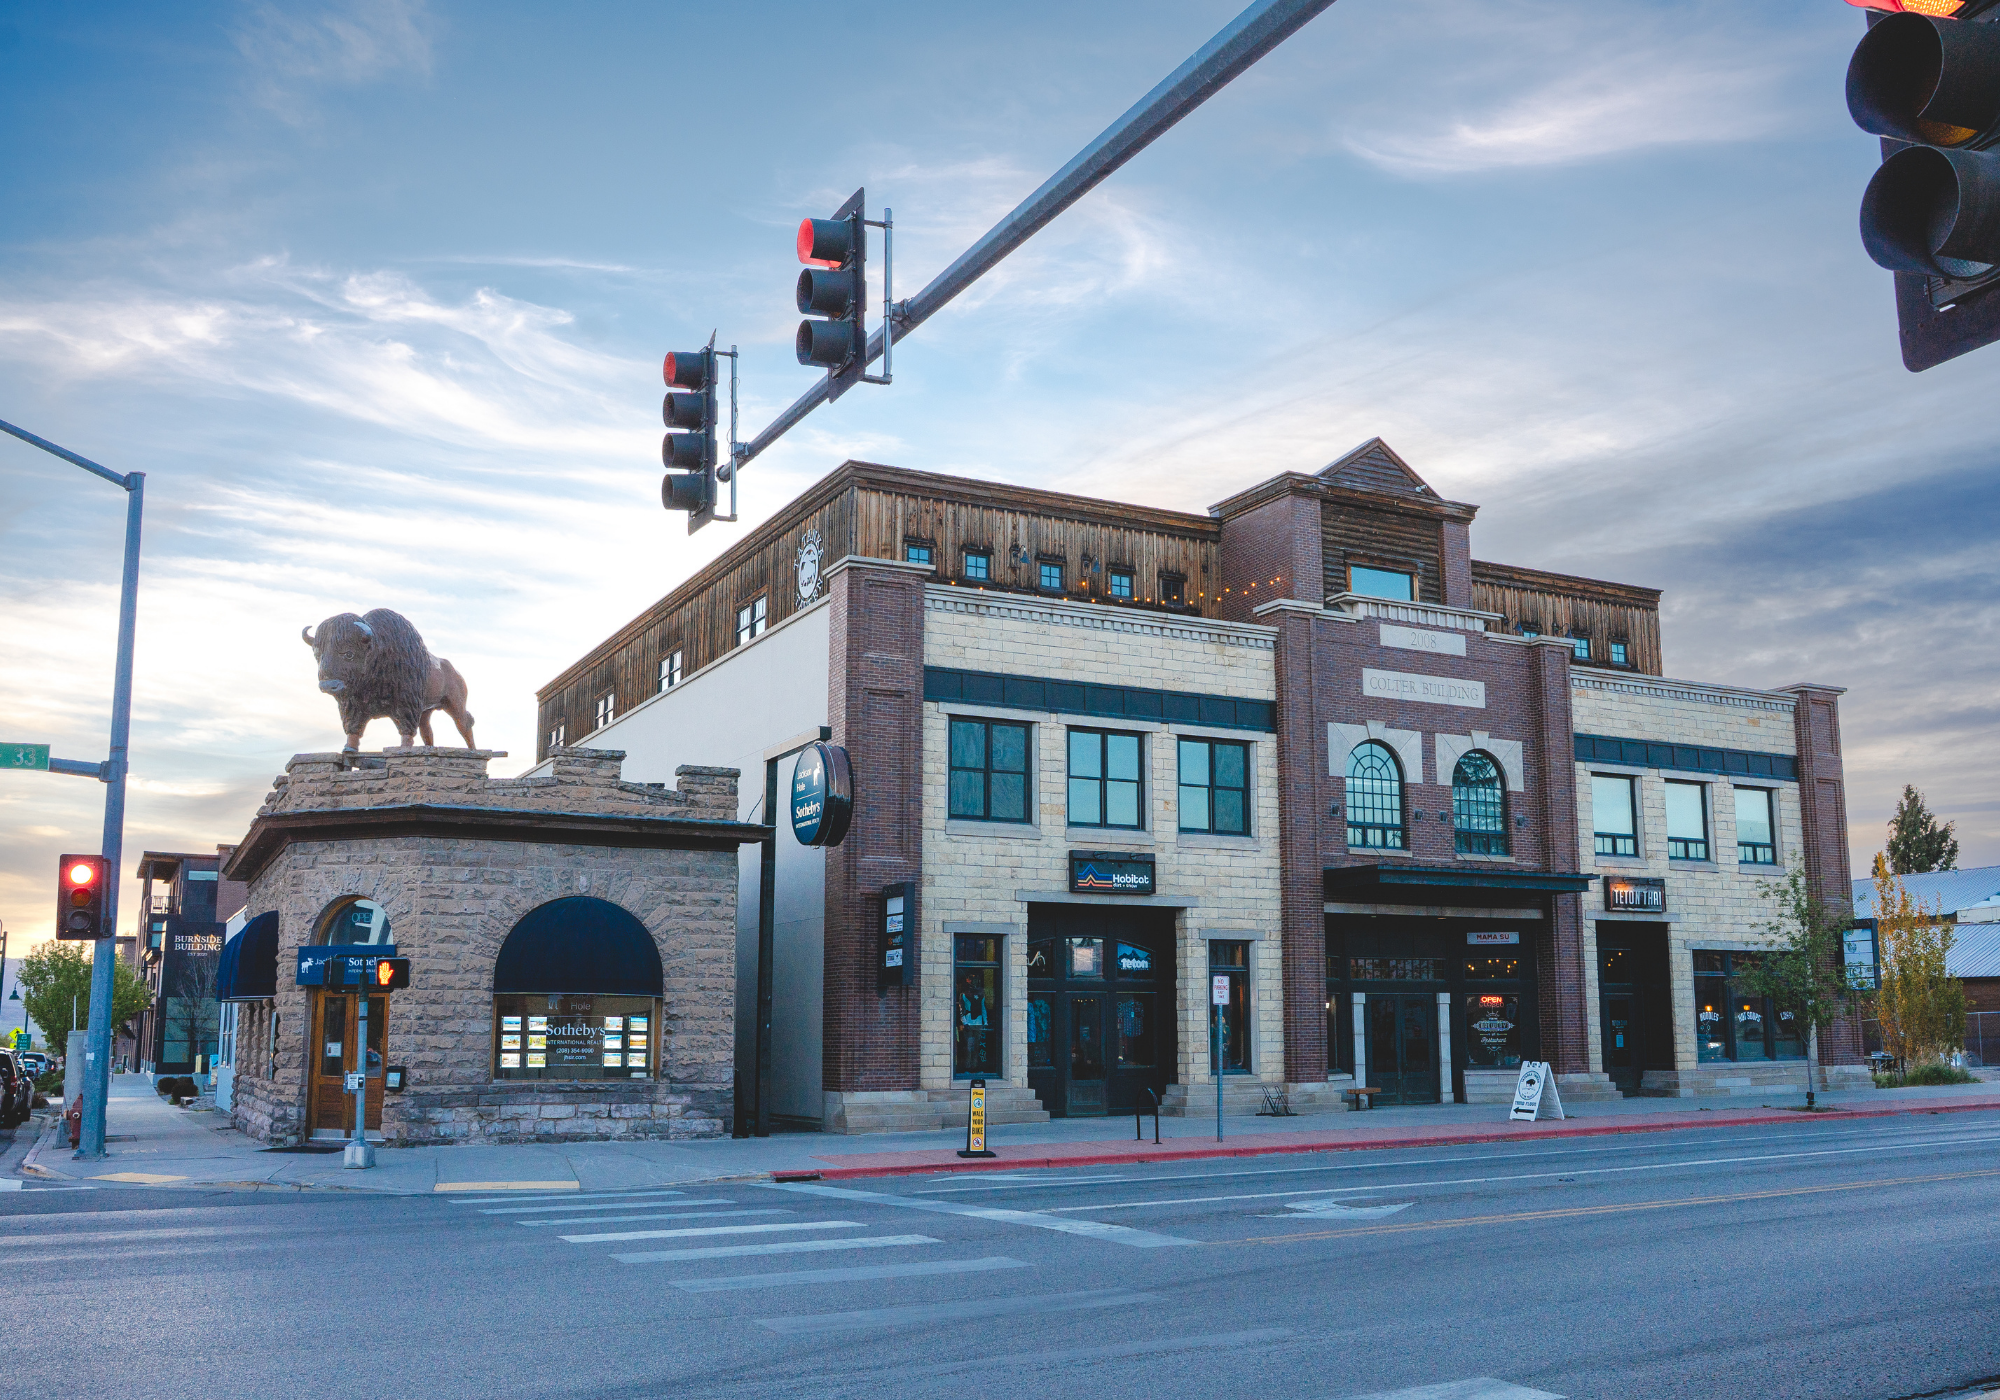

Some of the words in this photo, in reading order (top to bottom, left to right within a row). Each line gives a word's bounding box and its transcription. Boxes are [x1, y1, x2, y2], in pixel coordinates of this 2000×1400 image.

[1411, 631, 1437, 649] 2008
[1369, 676, 1417, 694] COLTER
[1422, 682, 1480, 700] BUILDING
[12, 747, 36, 767] 33
[797, 768, 812, 780] Jackson
[796, 782, 806, 793] Hole
[796, 800, 820, 819] Sotheby's
[1112, 873, 1149, 884] Habitat
[1613, 889, 1641, 905] TETON
[1643, 890, 1662, 906] THAI
[174, 935, 222, 943] BURNSIDE
[174, 943, 221, 951] BUILDING
[570, 1001, 591, 1011] Hole
[545, 1022, 606, 1038] Sotheby's
[972, 1127, 983, 1135] BIKE
